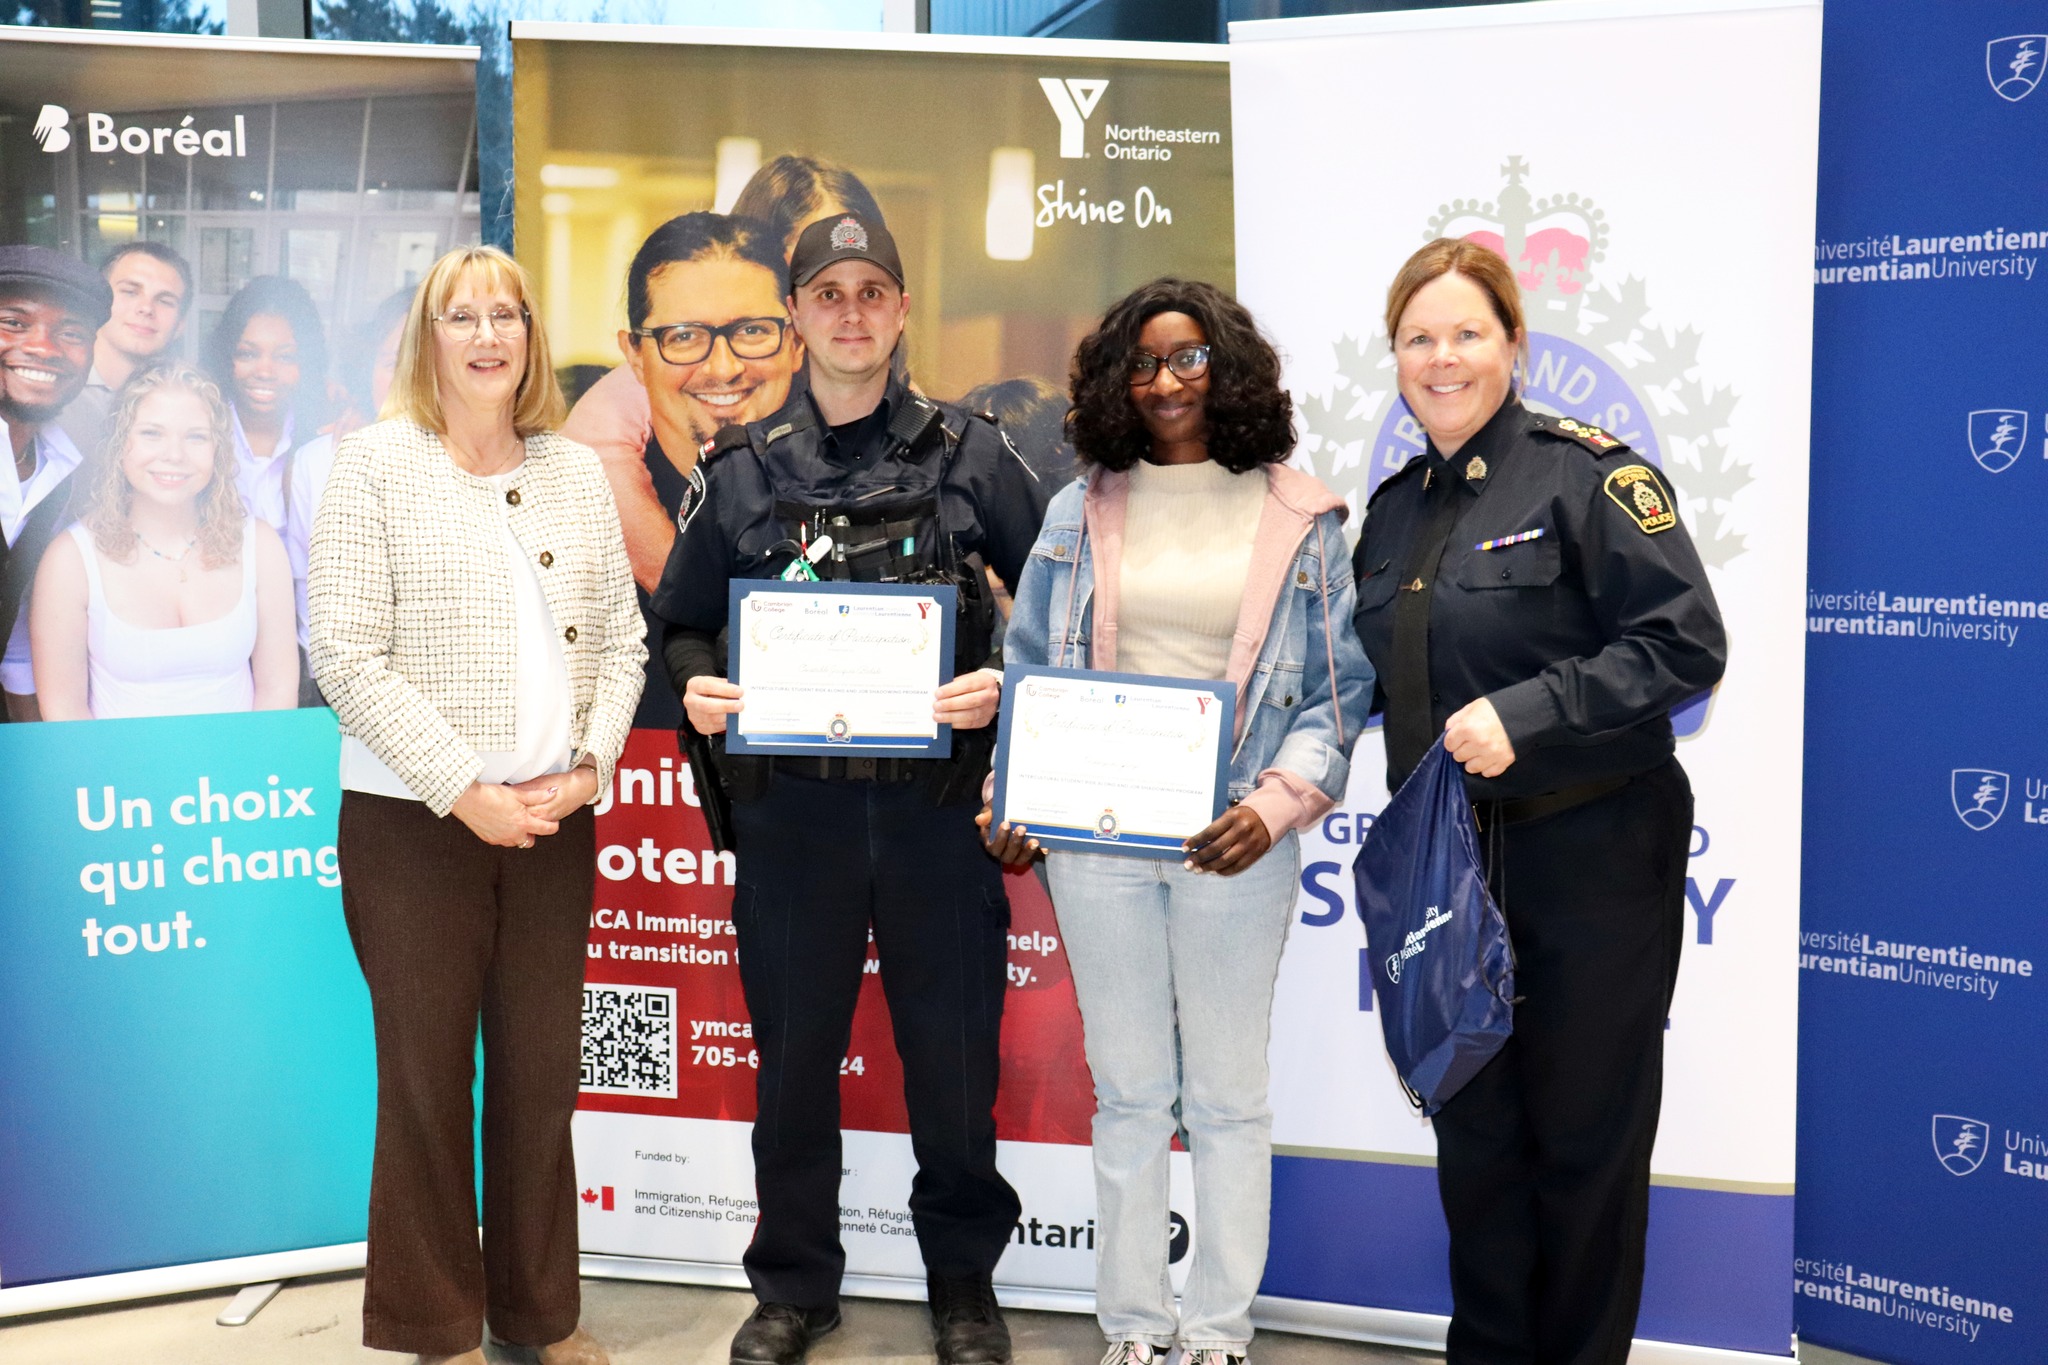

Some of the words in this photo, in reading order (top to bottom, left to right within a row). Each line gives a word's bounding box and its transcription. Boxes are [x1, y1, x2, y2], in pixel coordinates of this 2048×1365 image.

[88, 112, 247, 157] Boréal
[1105, 124, 1220, 144] Northeastern
[1104, 143, 1172, 161] Ontario
[1035, 179, 1125, 228] Shine
[1135, 186, 1172, 228] On
[1641, 512, 1674, 530] POLICE
[76, 786, 152, 831] Un
[169, 775, 316, 825] choix
[79, 844, 166, 905] qui
[183, 837, 342, 888] chang
[597, 838, 736, 886] oten
[81, 911, 207, 957] tout.
[589, 909, 631, 930] CA
[636, 910, 738, 940] Immigra
[608, 941, 729, 965] transition
[690, 1020, 752, 1040] ymca
[691, 1045, 759, 1069] 705-6
[635, 1150, 672, 1162] Funded
[675, 1154, 690, 1165] by:
[635, 1189, 704, 1206] Immigration,
[709, 1194, 757, 1210] Refugee
[635, 1205, 656, 1215] and
[659, 1205, 722, 1222] Citizenship
[726, 1210, 756, 1223] Cana
[868, 1207, 913, 1223] Réfugié
[1008, 1217, 1095, 1250] ntari
